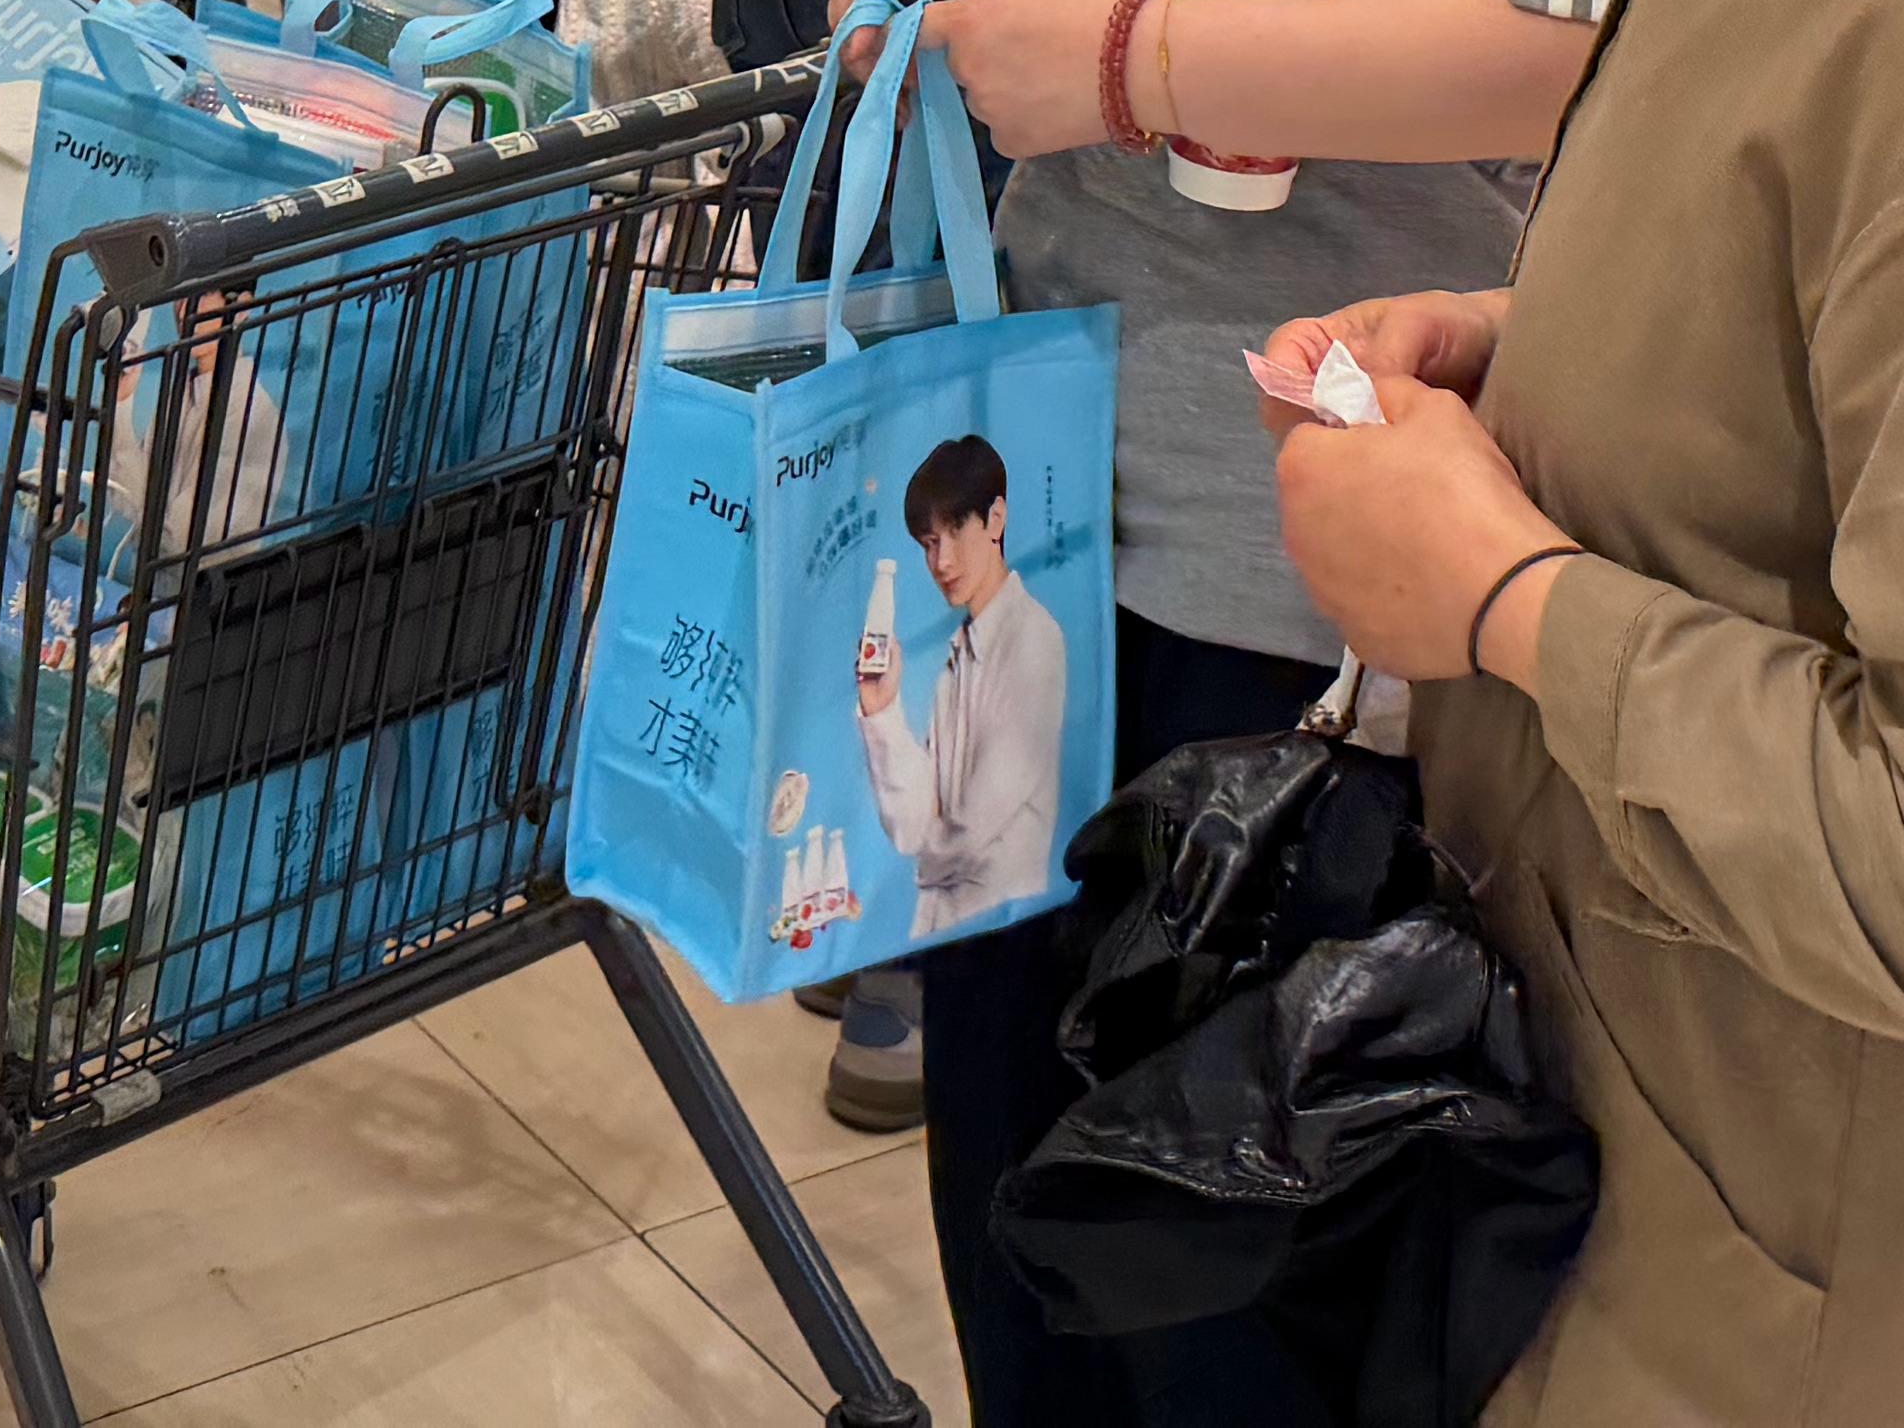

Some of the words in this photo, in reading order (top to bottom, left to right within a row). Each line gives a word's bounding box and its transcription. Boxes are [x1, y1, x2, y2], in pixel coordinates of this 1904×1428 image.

[54, 130, 126, 178] Purjoy
[775, 440, 837, 488] Purjoy
[688, 477, 756, 544] Purj
